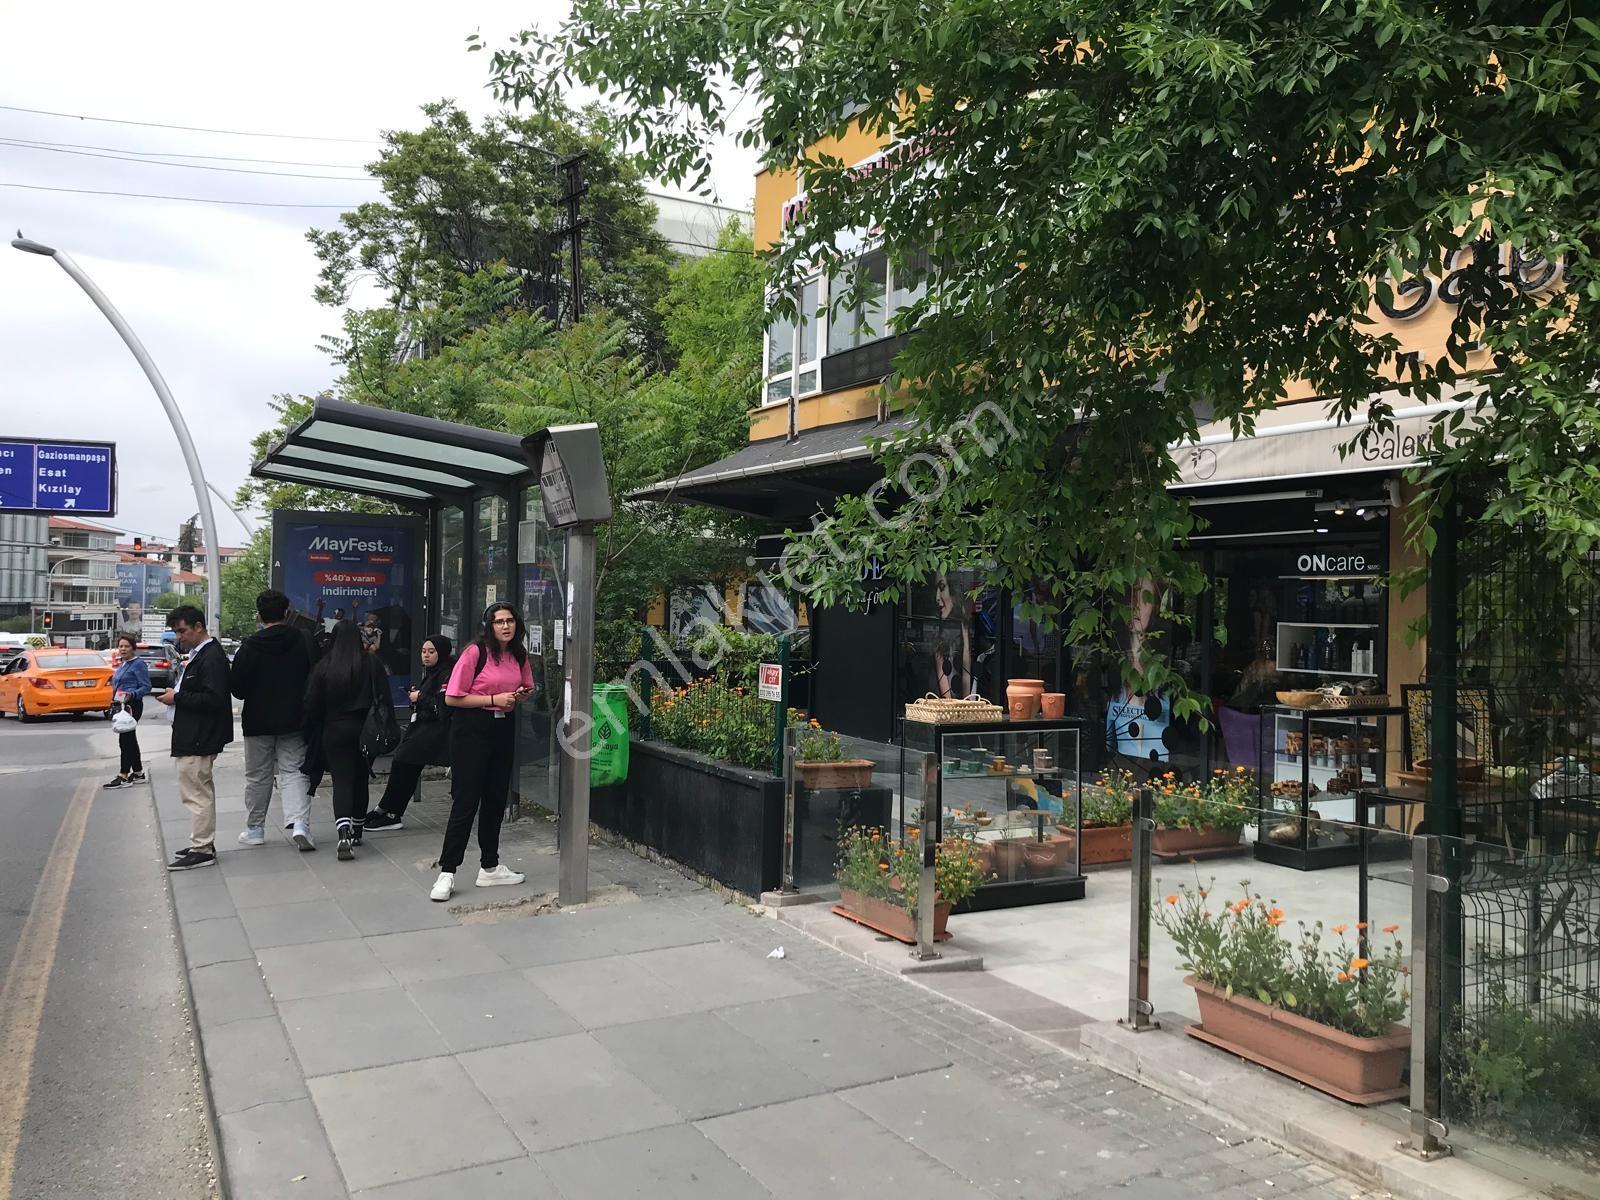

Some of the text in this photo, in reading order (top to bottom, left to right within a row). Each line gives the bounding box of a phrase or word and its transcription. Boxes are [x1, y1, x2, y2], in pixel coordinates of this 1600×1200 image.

[38, 450, 106, 463] Gaziosmanpaşa
[39, 467, 67, 477] Esat
[39, 483, 82, 496] Kızılay
[1297, 554, 1365, 572] ONcare
[352, 575, 376, 583] varan
[322, 586, 377, 597] indirimler!
